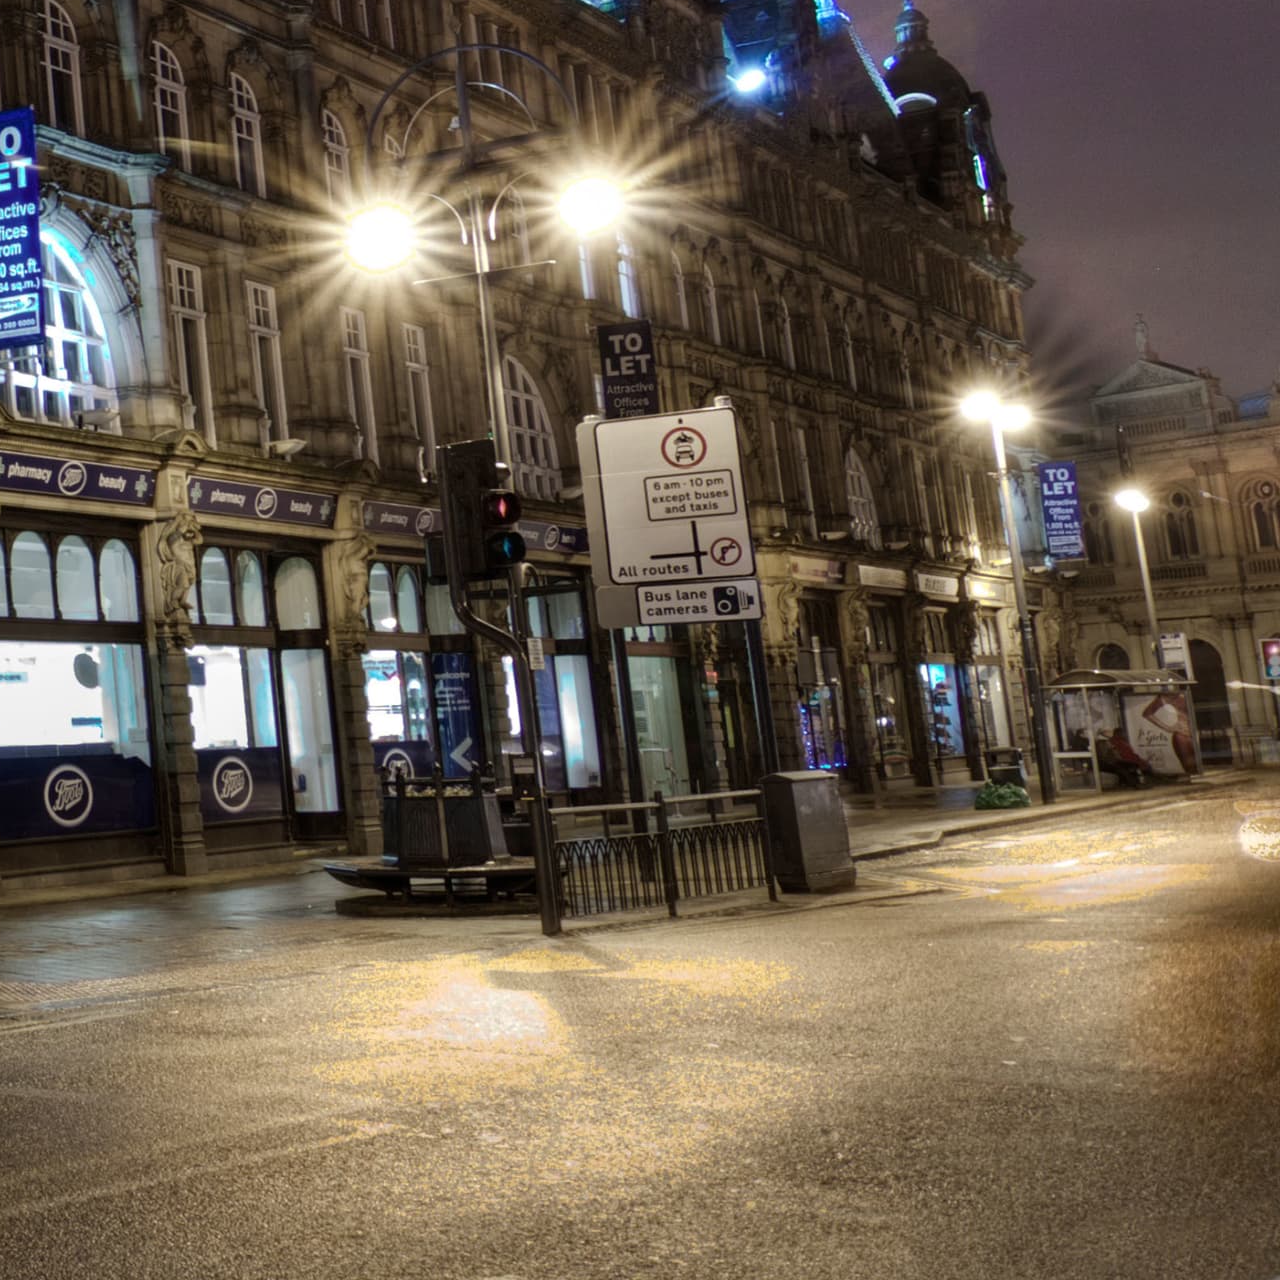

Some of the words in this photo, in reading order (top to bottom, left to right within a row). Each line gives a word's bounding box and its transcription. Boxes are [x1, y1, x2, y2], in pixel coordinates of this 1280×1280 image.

[608, 332, 642, 355] TO
[605, 354, 651, 376] LET
[607, 382, 654, 394] Attractive
[614, 397, 649, 408] Offices
[7, 461, 52, 484] pharmacy
[98, 473, 127, 493] beauty
[1045, 468, 1069, 482] TO
[653, 482, 661, 491] 6
[663, 482, 681, 490] am
[689, 477, 703, 487] 10
[706, 478, 724, 487] pm
[1042, 481, 1075, 495] LET
[210, 488, 246, 508] pharmacy
[290, 499, 313, 516] beauty
[652, 492, 690, 504] except
[695, 489, 729, 499] buses
[665, 503, 686, 513] and
[690, 501, 718, 511] taxis
[618, 567, 638, 578] All
[642, 564, 689, 576] routes
[644, 591, 671, 602] Bus
[676, 589, 707, 600] lane
[646, 604, 708, 616] cameras
